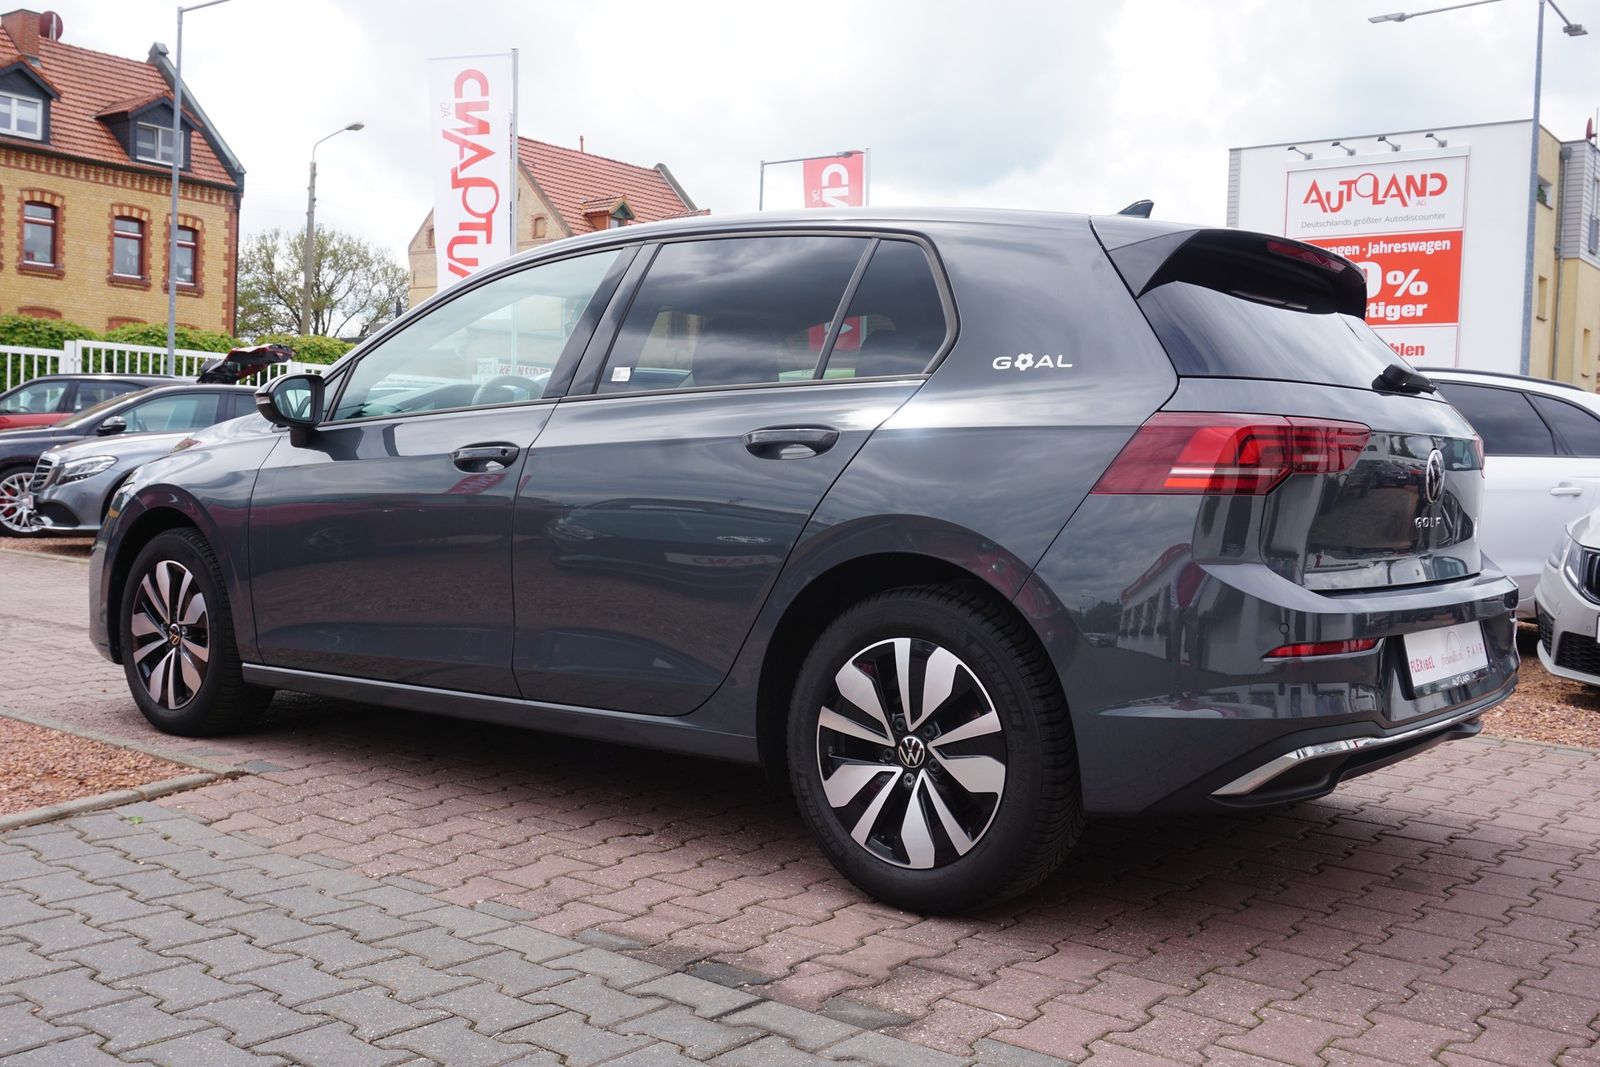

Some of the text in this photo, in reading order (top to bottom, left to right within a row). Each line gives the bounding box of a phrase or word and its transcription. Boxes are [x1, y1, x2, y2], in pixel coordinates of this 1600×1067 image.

[1303, 172, 1448, 213] AUTOLAND
[1301, 212, 1446, 229] Deutschlands größter Autodiscounter
[1366, 240, 1451, 257] Jahreswagen
[1364, 301, 1428, 320] tiger
[992, 353, 1073, 371] GOAL
[1415, 517, 1442, 528] GOLF
